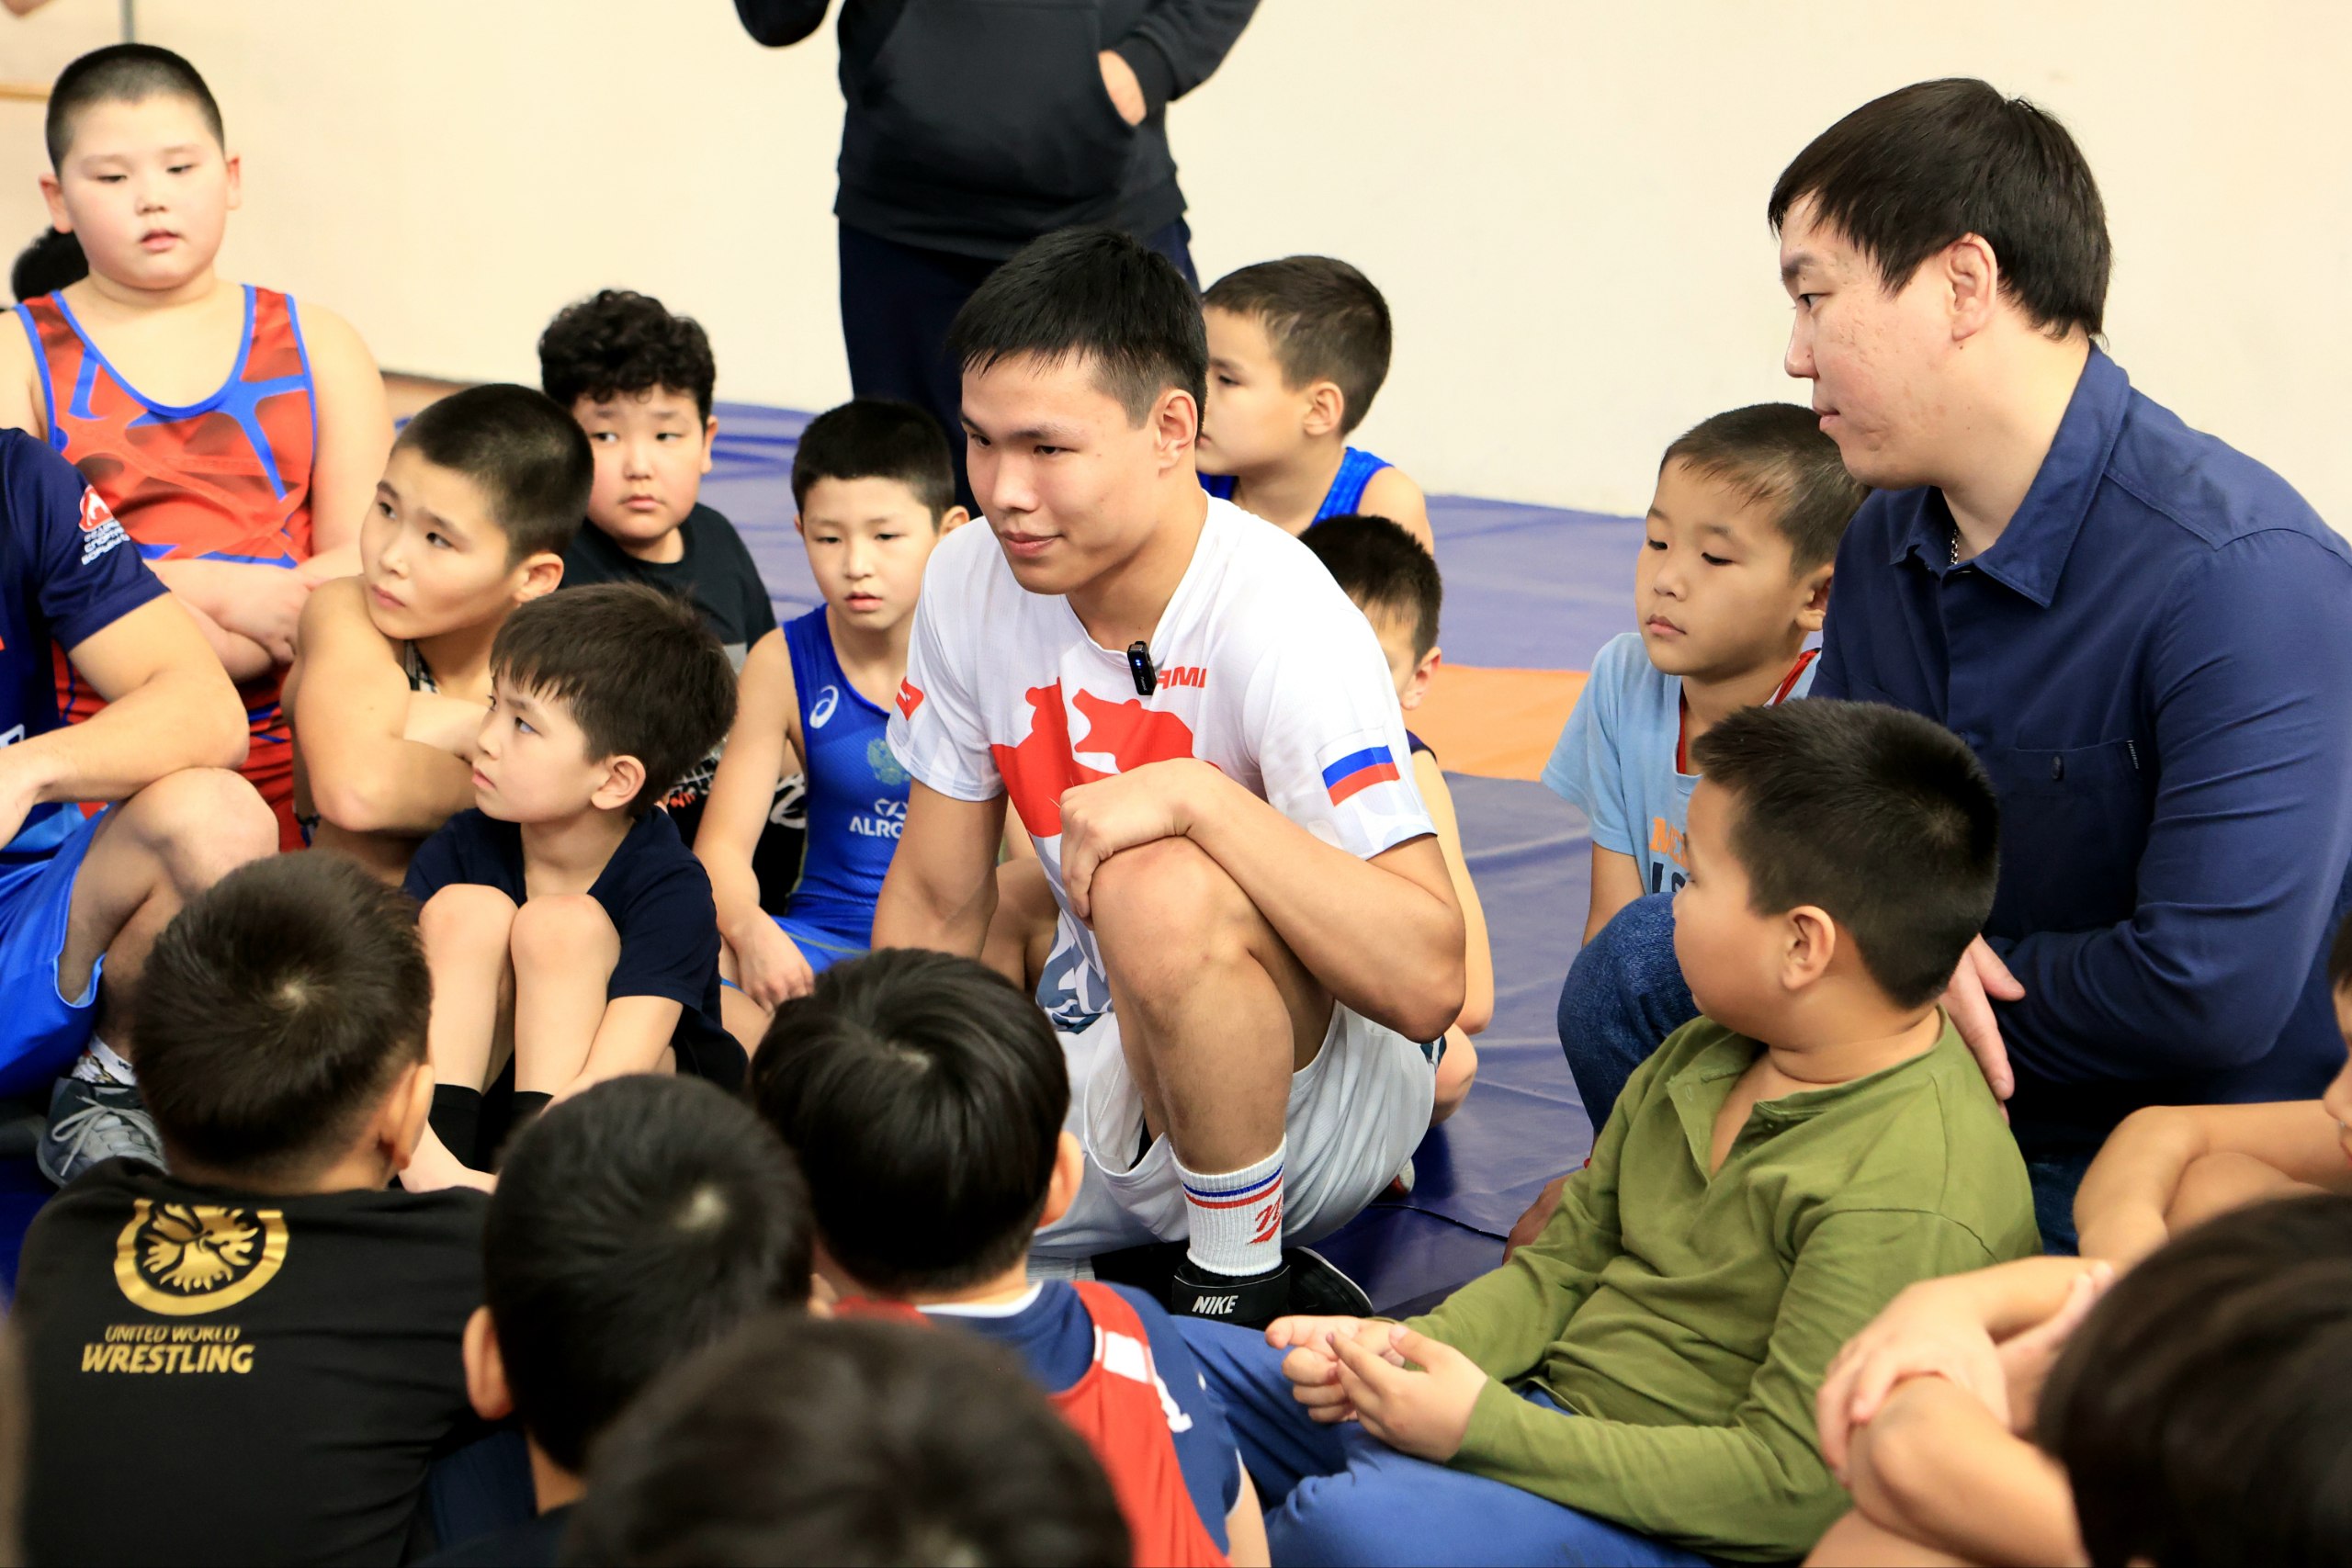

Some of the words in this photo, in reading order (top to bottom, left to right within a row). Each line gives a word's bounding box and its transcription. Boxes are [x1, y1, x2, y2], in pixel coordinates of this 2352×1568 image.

[1192, 1295, 1238, 1314] NIKE
[105, 1325, 169, 1342] UNITED
[172, 1325, 241, 1342] WORLD
[81, 1344, 255, 1374] WRESTLING
